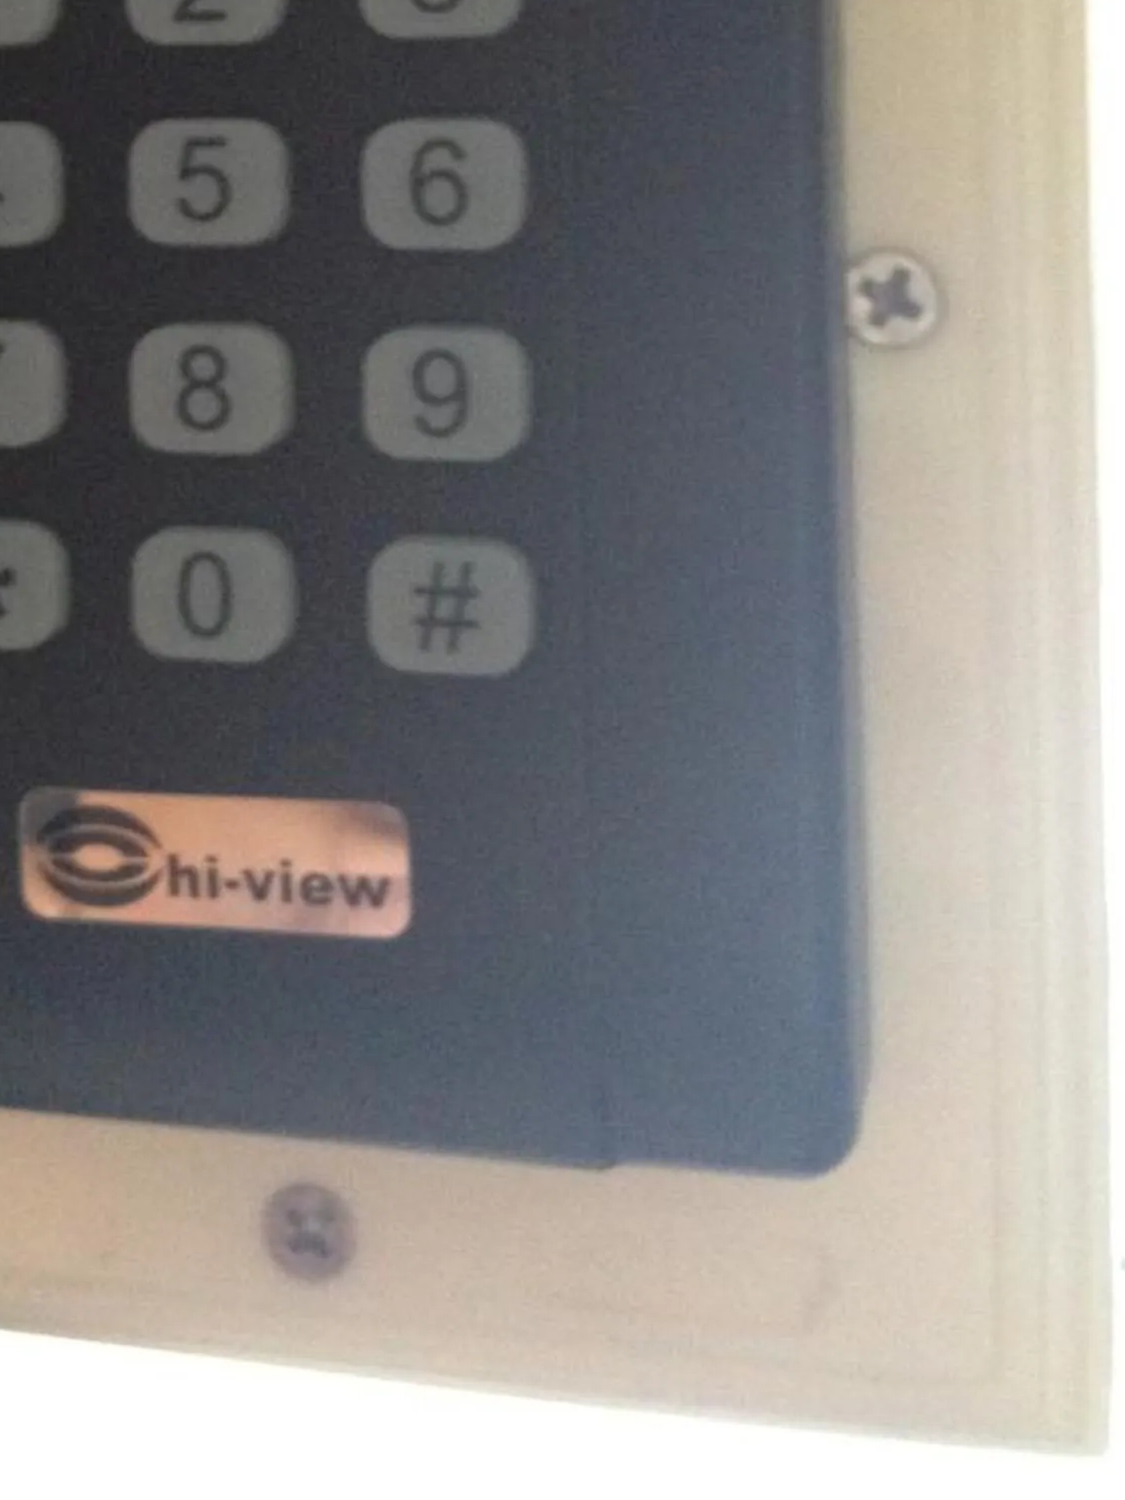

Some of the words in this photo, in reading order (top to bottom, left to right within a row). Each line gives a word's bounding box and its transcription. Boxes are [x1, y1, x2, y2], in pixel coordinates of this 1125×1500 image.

[174, 136, 233, 223] 5
[408, 137, 470, 227] 6
[174, 344, 232, 432] 8
[410, 348, 470, 438] 9
[176, 549, 235, 638] 0
[413, 560, 482, 655] #
[166, 853, 392, 908] hi-view
